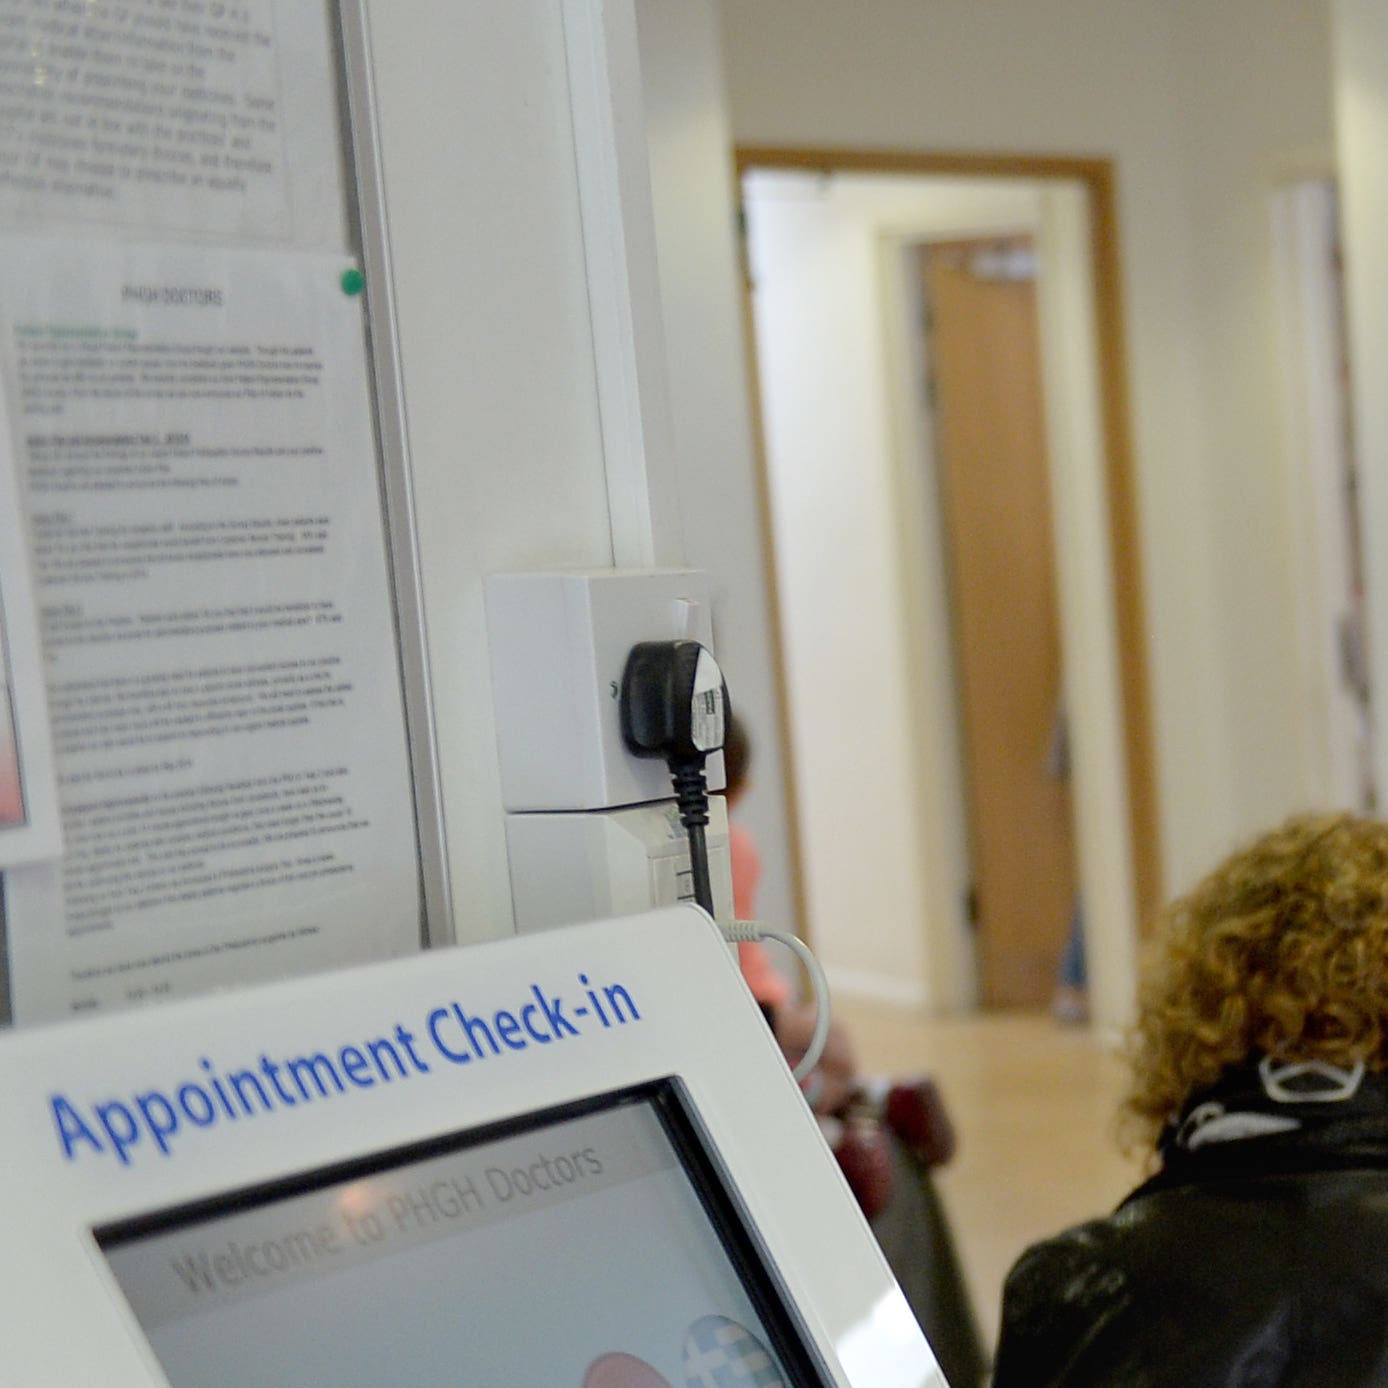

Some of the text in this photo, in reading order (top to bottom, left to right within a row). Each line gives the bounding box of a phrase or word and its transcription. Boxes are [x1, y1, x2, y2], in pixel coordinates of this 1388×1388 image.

[48, 973, 641, 1166] Appointment Check-in
[171, 1145, 605, 1294] Welcome to PHGH Doctors
